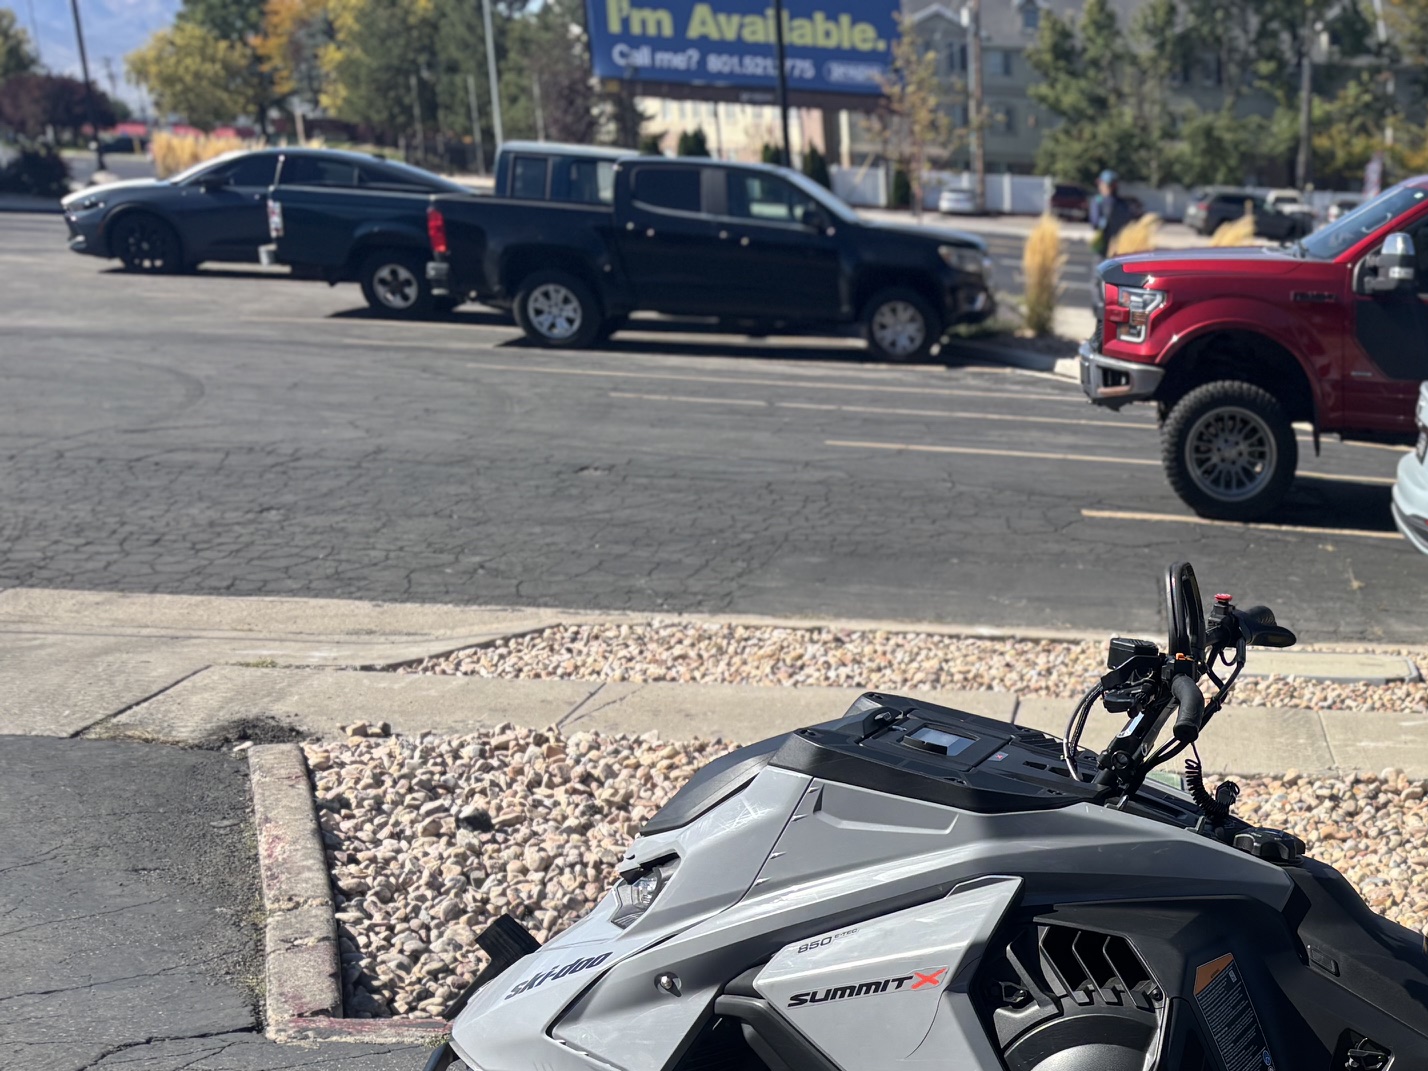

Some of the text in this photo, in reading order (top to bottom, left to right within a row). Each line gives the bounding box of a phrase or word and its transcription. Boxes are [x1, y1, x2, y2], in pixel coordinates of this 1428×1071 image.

[606, 0, 887, 52] I'm Available.
[612, 43, 652, 67] Call
[654, 48, 700, 70] me?
[797, 936, 833, 954] 850
